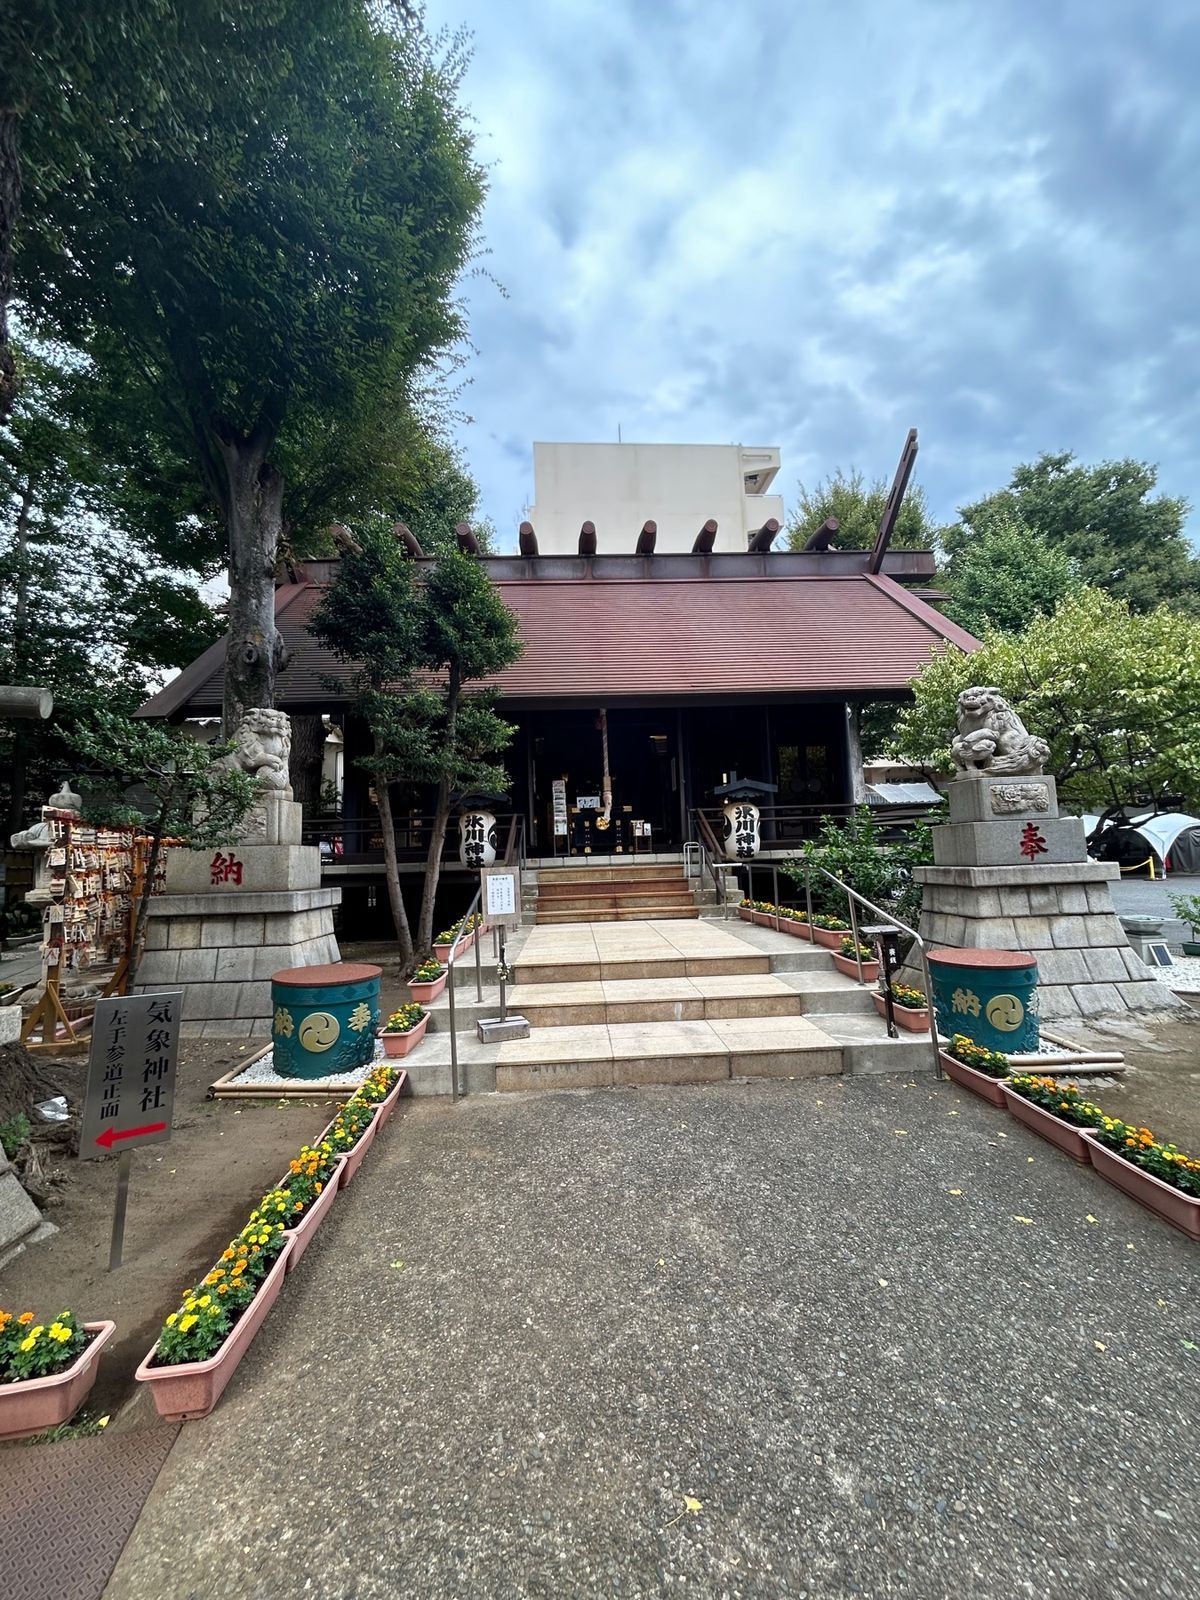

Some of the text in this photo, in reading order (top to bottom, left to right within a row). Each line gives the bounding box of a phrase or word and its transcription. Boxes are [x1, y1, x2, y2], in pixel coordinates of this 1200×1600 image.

[464, 814, 486, 870] 氷川神社
[734, 805, 756, 859] 氷川神社
[1019, 822, 1049, 861] 奉
[210, 851, 244, 886] 納
[346, 1001, 372, 1033] 奉
[951, 987, 982, 1018] 納
[100, 1009, 129, 1120] 左手参道正面
[139, 1000, 173, 1113] 気象神社
